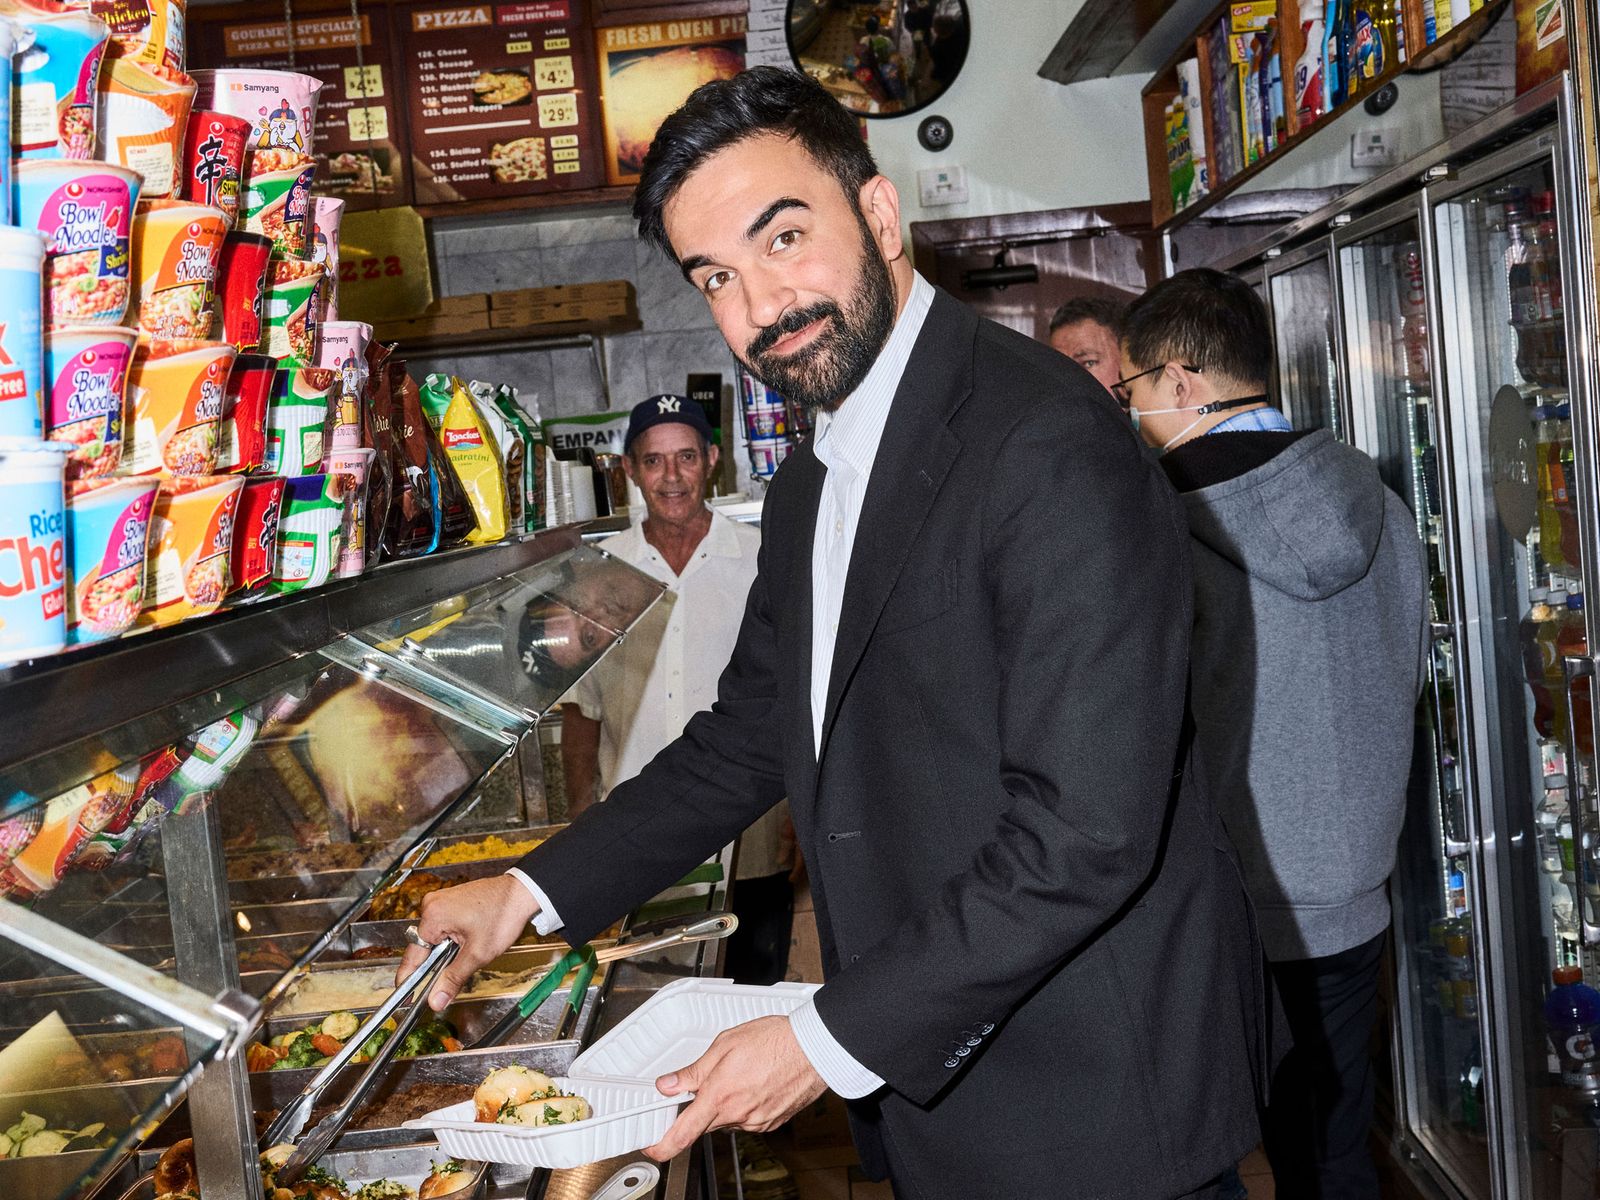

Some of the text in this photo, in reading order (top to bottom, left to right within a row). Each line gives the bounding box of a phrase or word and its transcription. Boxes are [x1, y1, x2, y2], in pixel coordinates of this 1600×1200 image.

[417, 8, 488, 29] PIZZA
[605, 24, 662, 47] FRESH
[667, 19, 715, 41] OVEN
[720, 14, 748, 34] PIZ
[238, 40, 271, 51] PIZZA
[273, 36, 315, 49] SLCES
[437, 48, 468, 57] Cheese
[439, 60, 473, 68] Sausage
[243, 83, 280, 94] Samyang
[441, 95, 468, 104] Olives
[442, 107, 468, 116] Green
[469, 104, 503, 113] Peppers
[195, 134, 228, 206] 辛
[450, 159, 480, 169] Stuffed
[60, 201, 104, 225] Bowl
[55, 224, 118, 250] Noodles
[182, 240, 213, 261] Bowl
[322, 335, 349, 344] Samyang
[74, 368, 113, 393] Bowl
[692, 391, 715, 399] UBER
[656, 395, 682, 414] NY
[344, 461, 363, 469] Samyang
[30, 509, 62, 538] Rice
